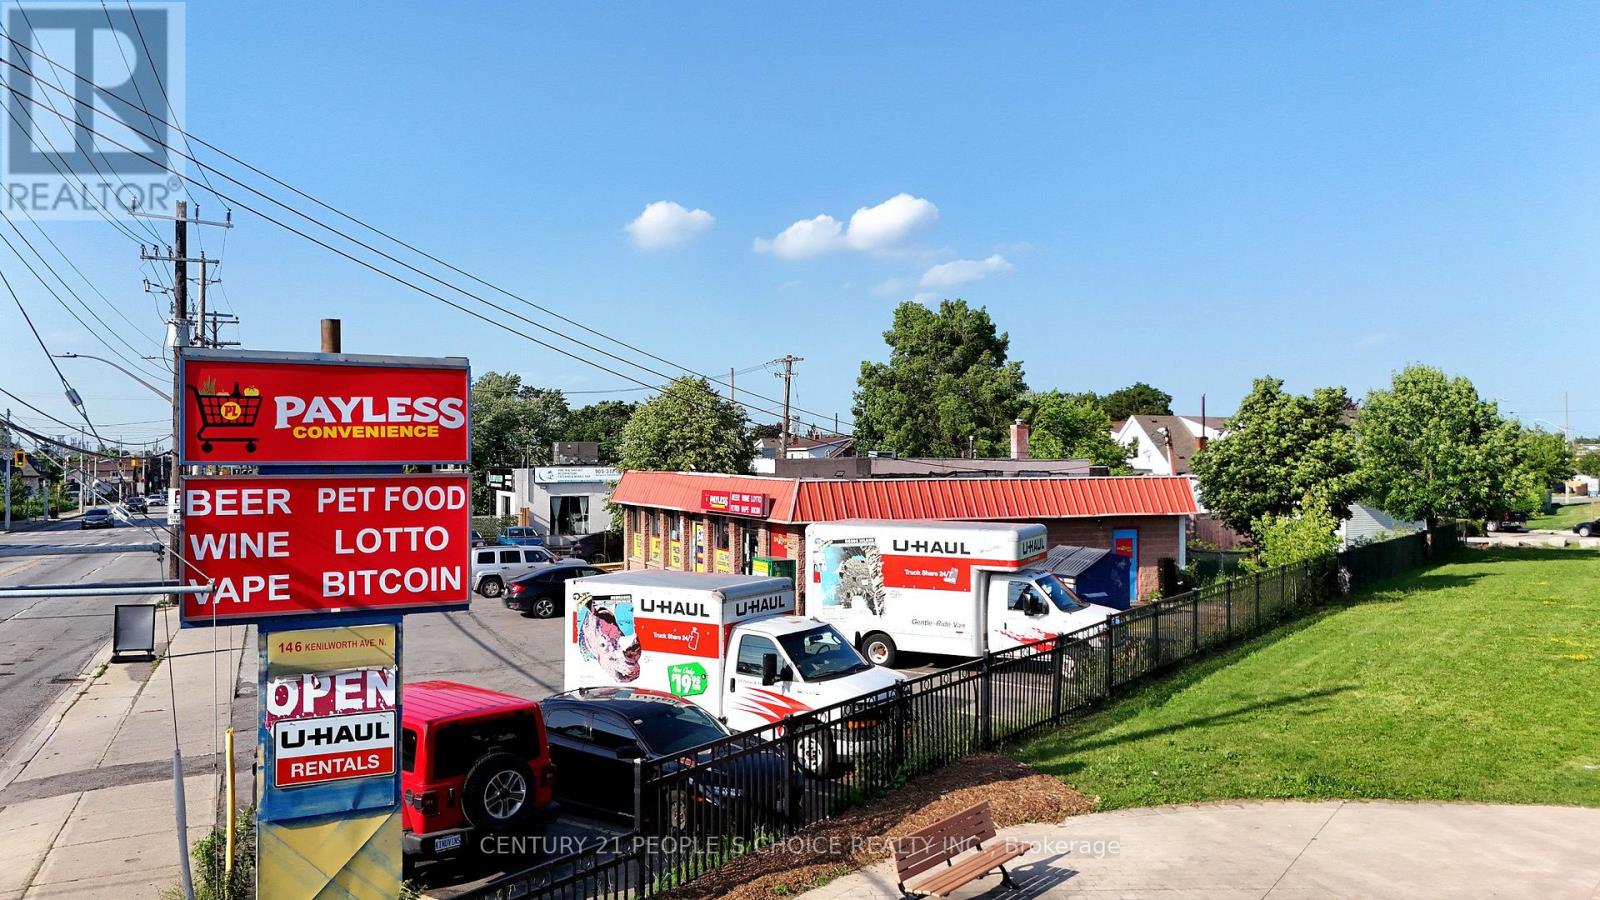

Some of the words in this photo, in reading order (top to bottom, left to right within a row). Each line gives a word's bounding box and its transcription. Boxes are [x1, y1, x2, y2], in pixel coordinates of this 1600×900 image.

[274, 396, 465, 430] PAYLESS
[292, 425, 440, 439] CONVENIENCE
[187, 488, 292, 517] BEER
[317, 486, 375, 513] PET
[384, 485, 465, 512] FOOD
[189, 531, 290, 560] WINE
[335, 525, 449, 555] LOTTO
[892, 539, 971, 555] U-HAUL
[1022, 537, 1045, 555] U-HAUL
[322, 565, 461, 598] BITCOIN
[904, 568, 921, 577] Truck
[921, 569, 938, 577] Share
[188, 574, 290, 605] VAPE
[640, 598, 710, 618] U-HAUL
[735, 595, 786, 617] U-HAUL
[278, 641, 303, 653] 146
[304, 640, 358, 651] KENILWORTH
[267, 669, 396, 717] OPEN
[281, 722, 390, 749] U-HAUL
[290, 754, 380, 778] RENTALS
